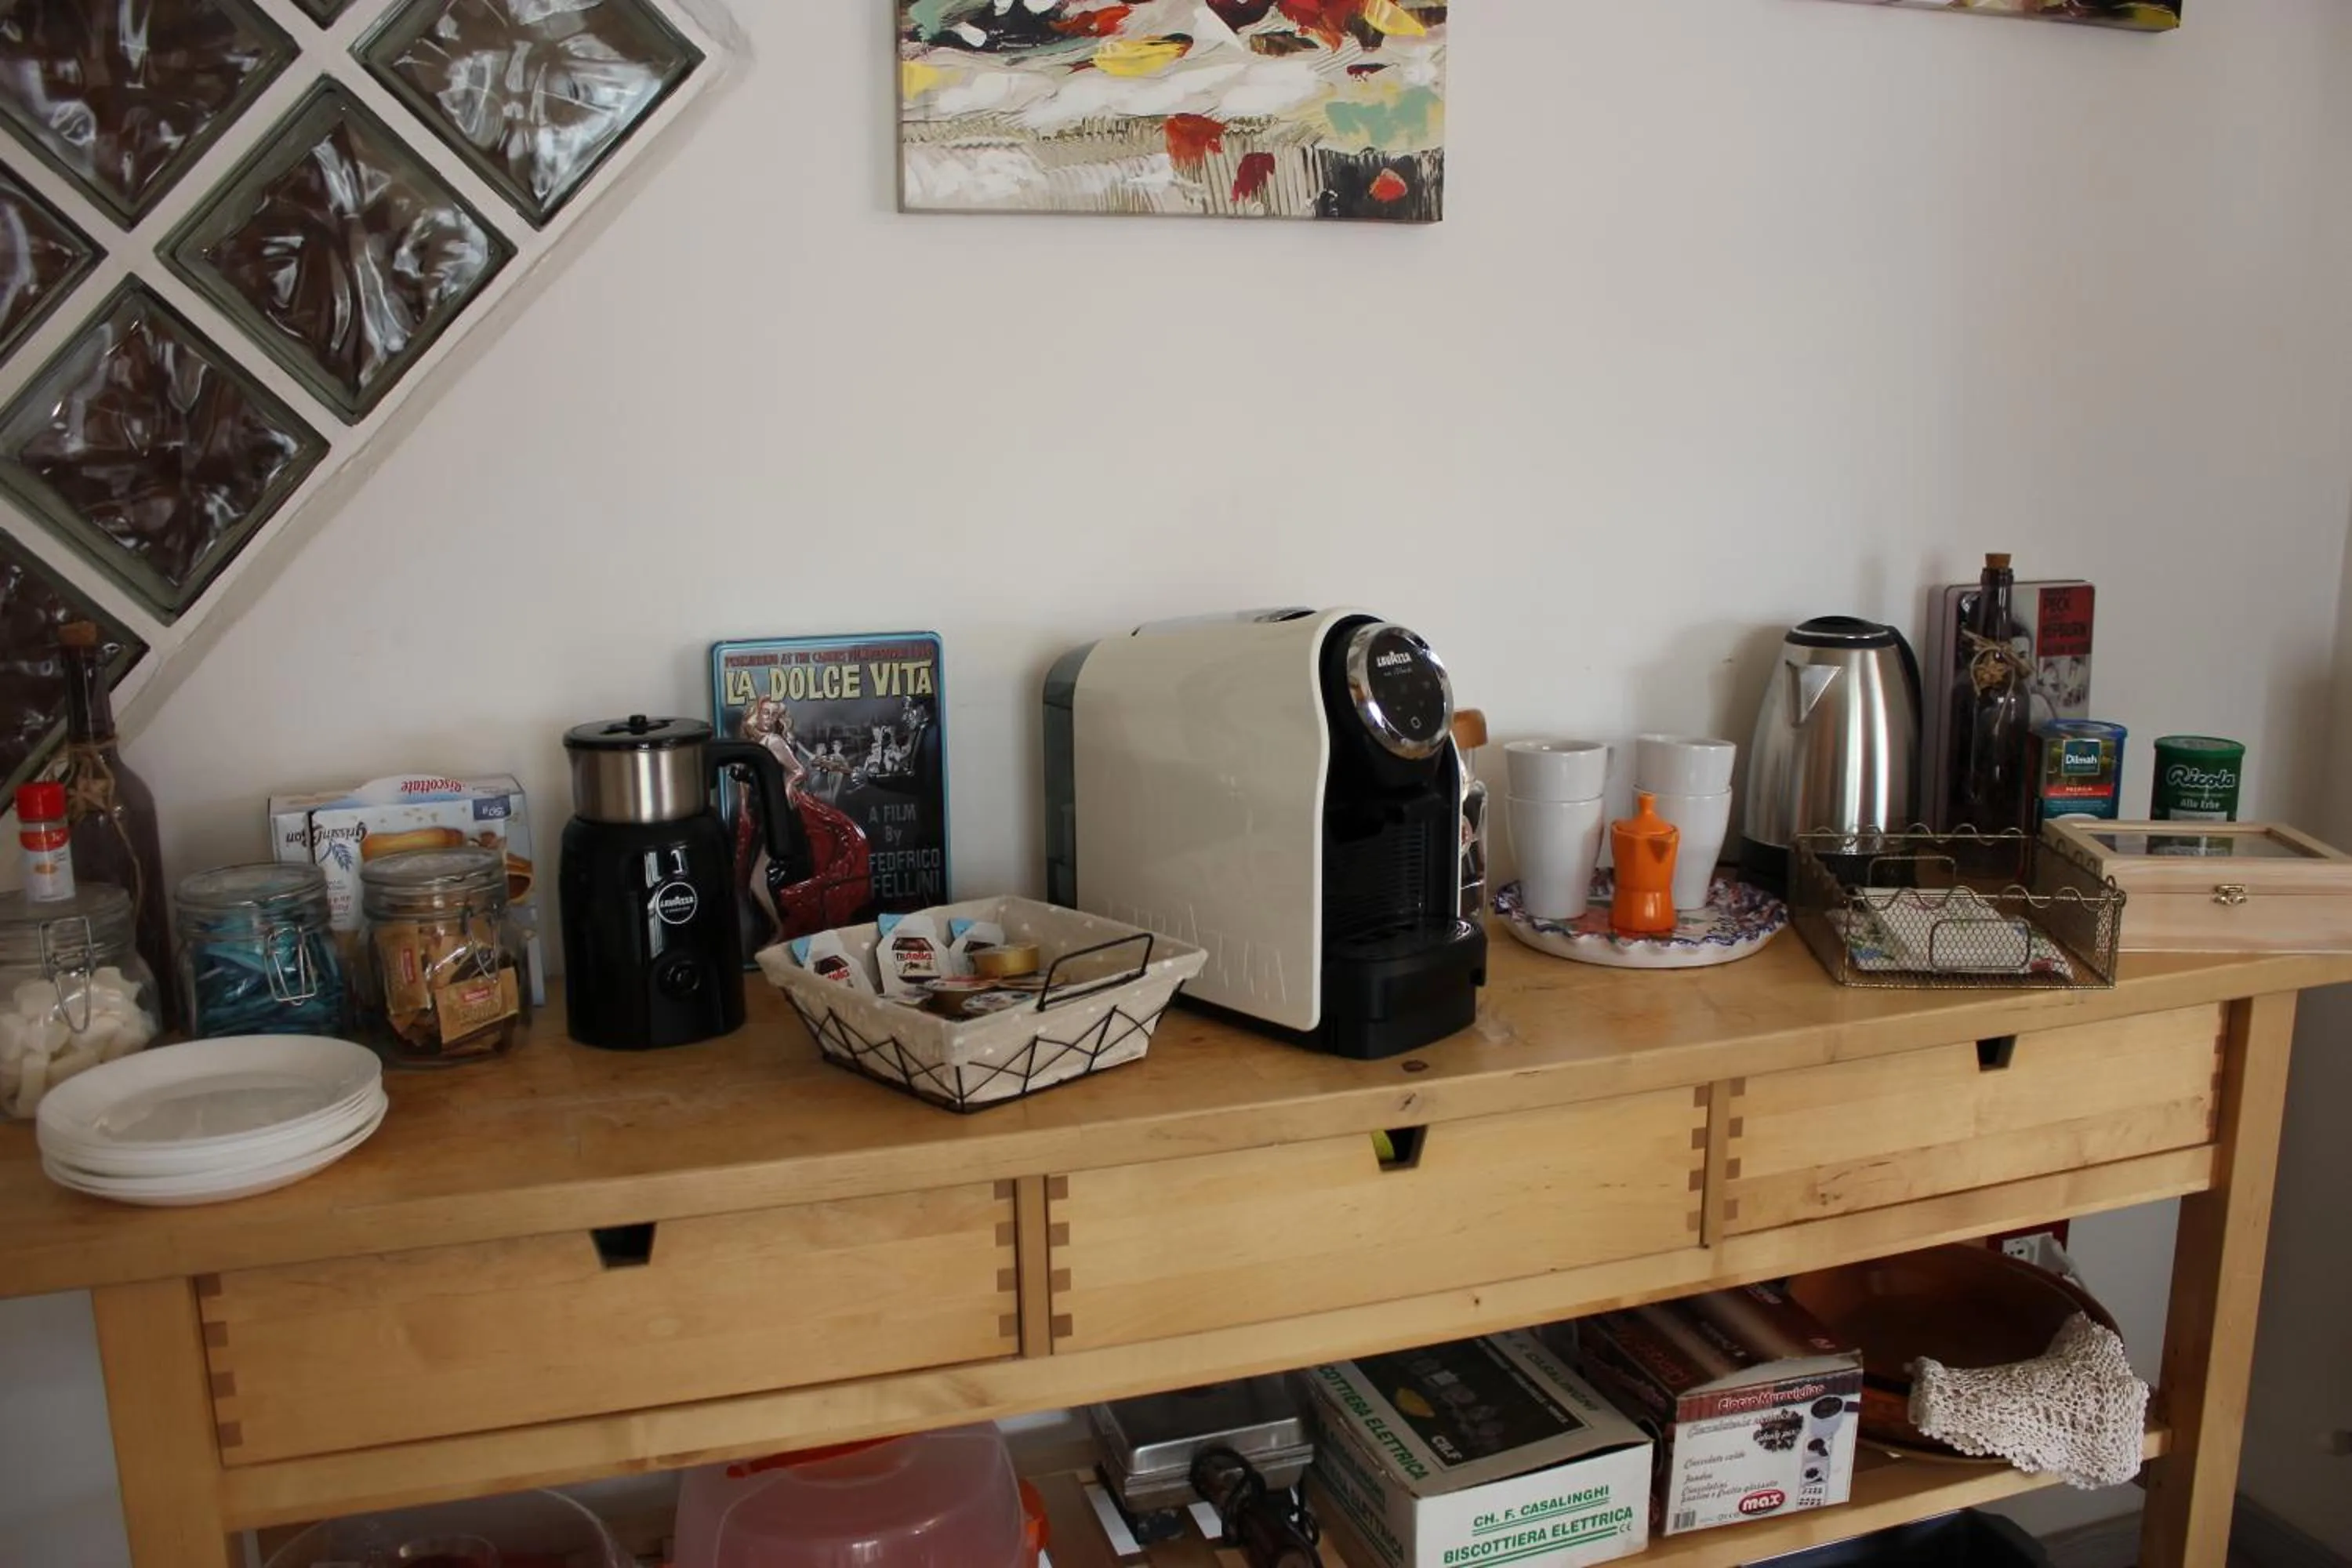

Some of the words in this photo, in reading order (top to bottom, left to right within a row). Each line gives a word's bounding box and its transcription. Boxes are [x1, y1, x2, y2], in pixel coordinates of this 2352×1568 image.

[725, 670, 757, 706] LA
[768, 664, 862, 702] DOLCE
[868, 659, 934, 697] VITA
[2065, 753, 2098, 764] Dilmah
[2166, 764, 2235, 789] Ricola
[868, 805, 879, 823] A
[884, 802, 916, 822] FILM
[884, 825, 903, 846] By
[868, 848, 941, 873] FEDERICO
[870, 869, 941, 901] FELLINI
[1364, 1417, 1429, 1481] ELETTRICA
[1472, 1513, 1499, 1529] CH.
[1504, 1508, 1515, 1521] F.
[1520, 1485, 1610, 1517] CASALINGHI
[1742, 1492, 1781, 1512] max
[1443, 1528, 1548, 1566] BISCOTTIERA
[1552, 1505, 1633, 1539] ELETTRICA
